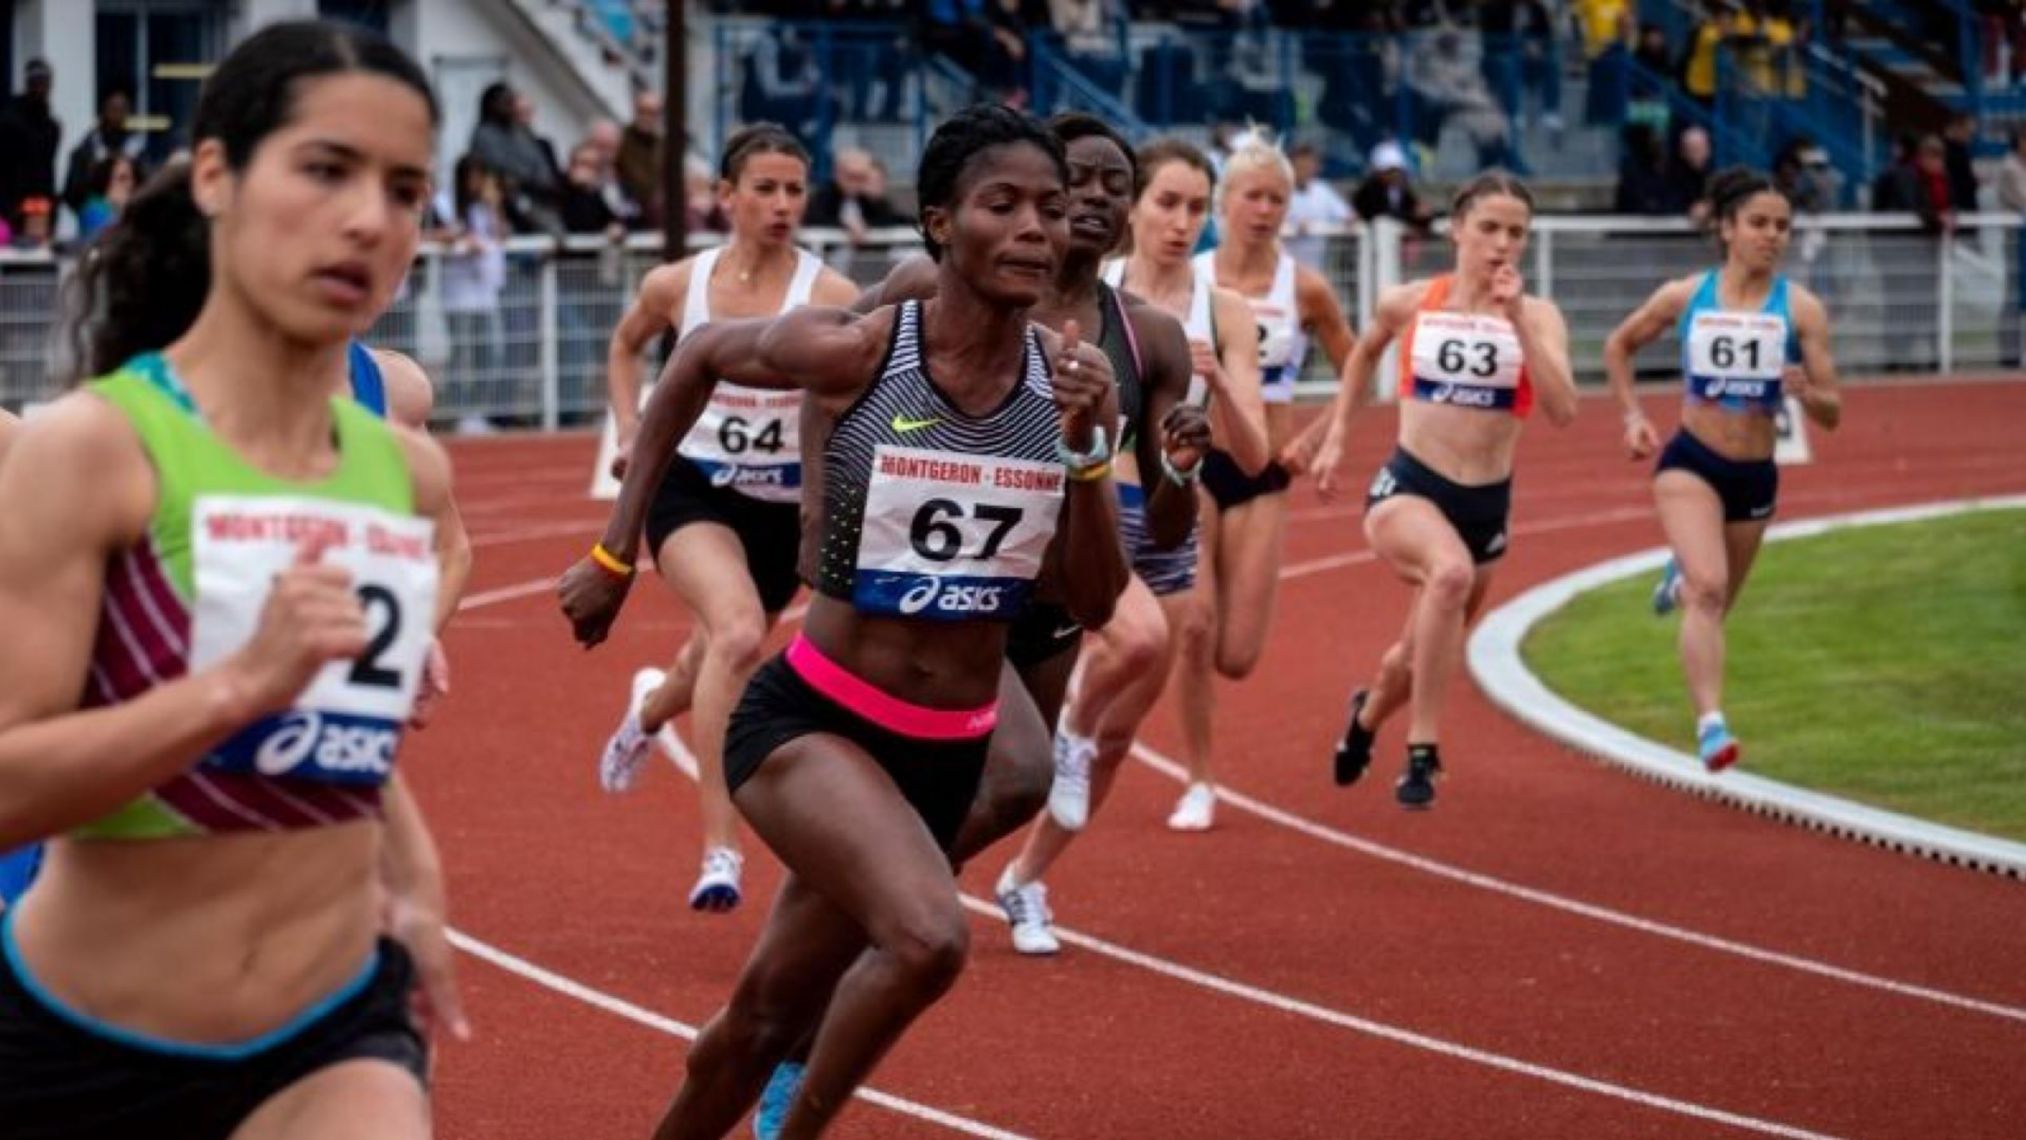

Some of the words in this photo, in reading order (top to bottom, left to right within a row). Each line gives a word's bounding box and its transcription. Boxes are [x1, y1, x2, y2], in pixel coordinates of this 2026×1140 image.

[1438, 339, 1498, 377] 63
[1711, 336, 1760, 370] 61
[719, 416, 785, 454] 64
[881, 454, 982, 484] MONTGERON
[910, 498, 1023, 562] 67
[938, 586, 1001, 611] asics
